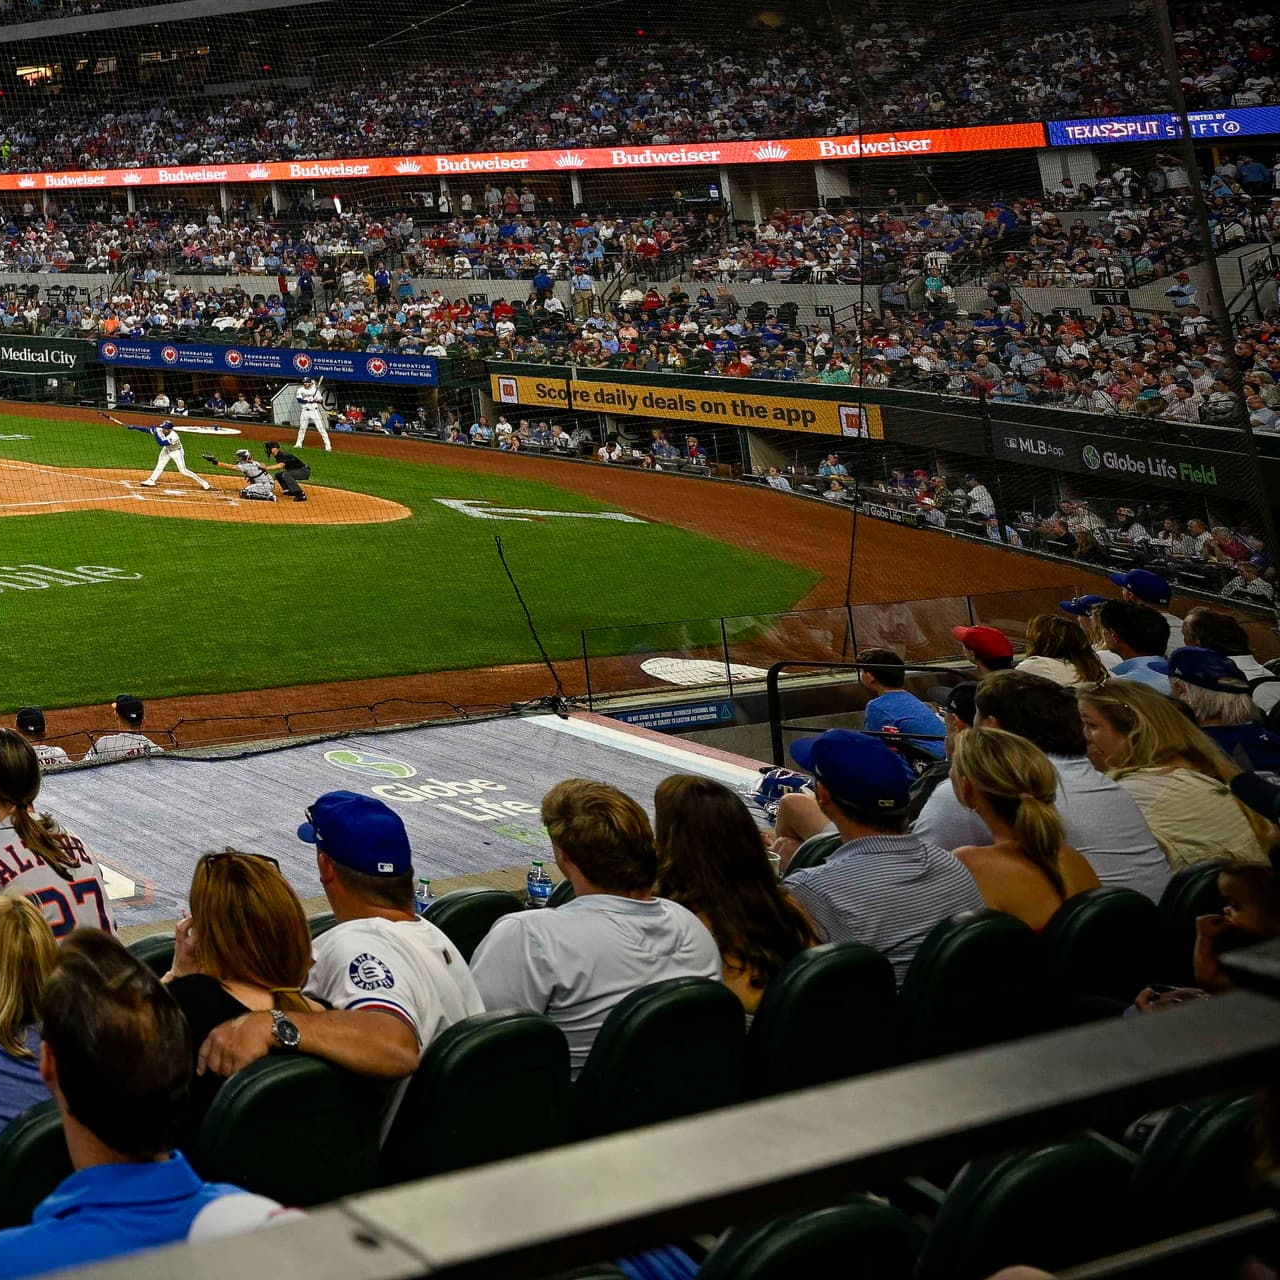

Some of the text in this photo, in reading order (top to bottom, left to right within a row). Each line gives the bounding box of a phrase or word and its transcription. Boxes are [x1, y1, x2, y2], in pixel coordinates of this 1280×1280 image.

[1065, 121, 1158, 139] TEXAS SPLIT
[818, 137, 932, 158] Budweiser
[436, 156, 529, 172] Budweiser
[610, 149, 721, 166] Budweiser
[158, 169, 228, 183] Budweiser
[290, 163, 371, 178] Budweiser
[45, 174, 107, 187] Budweiser
[1, 346, 77, 368] Medical City
[535, 383, 817, 428] Score daily deals on the app
[1018, 437, 1064, 457] MLB App
[1103, 451, 1218, 485] Globe Life Field
[870, 506, 889, 519] Globe
[889, 510, 902, 522] Life
[370, 778, 542, 822] Globe Life
